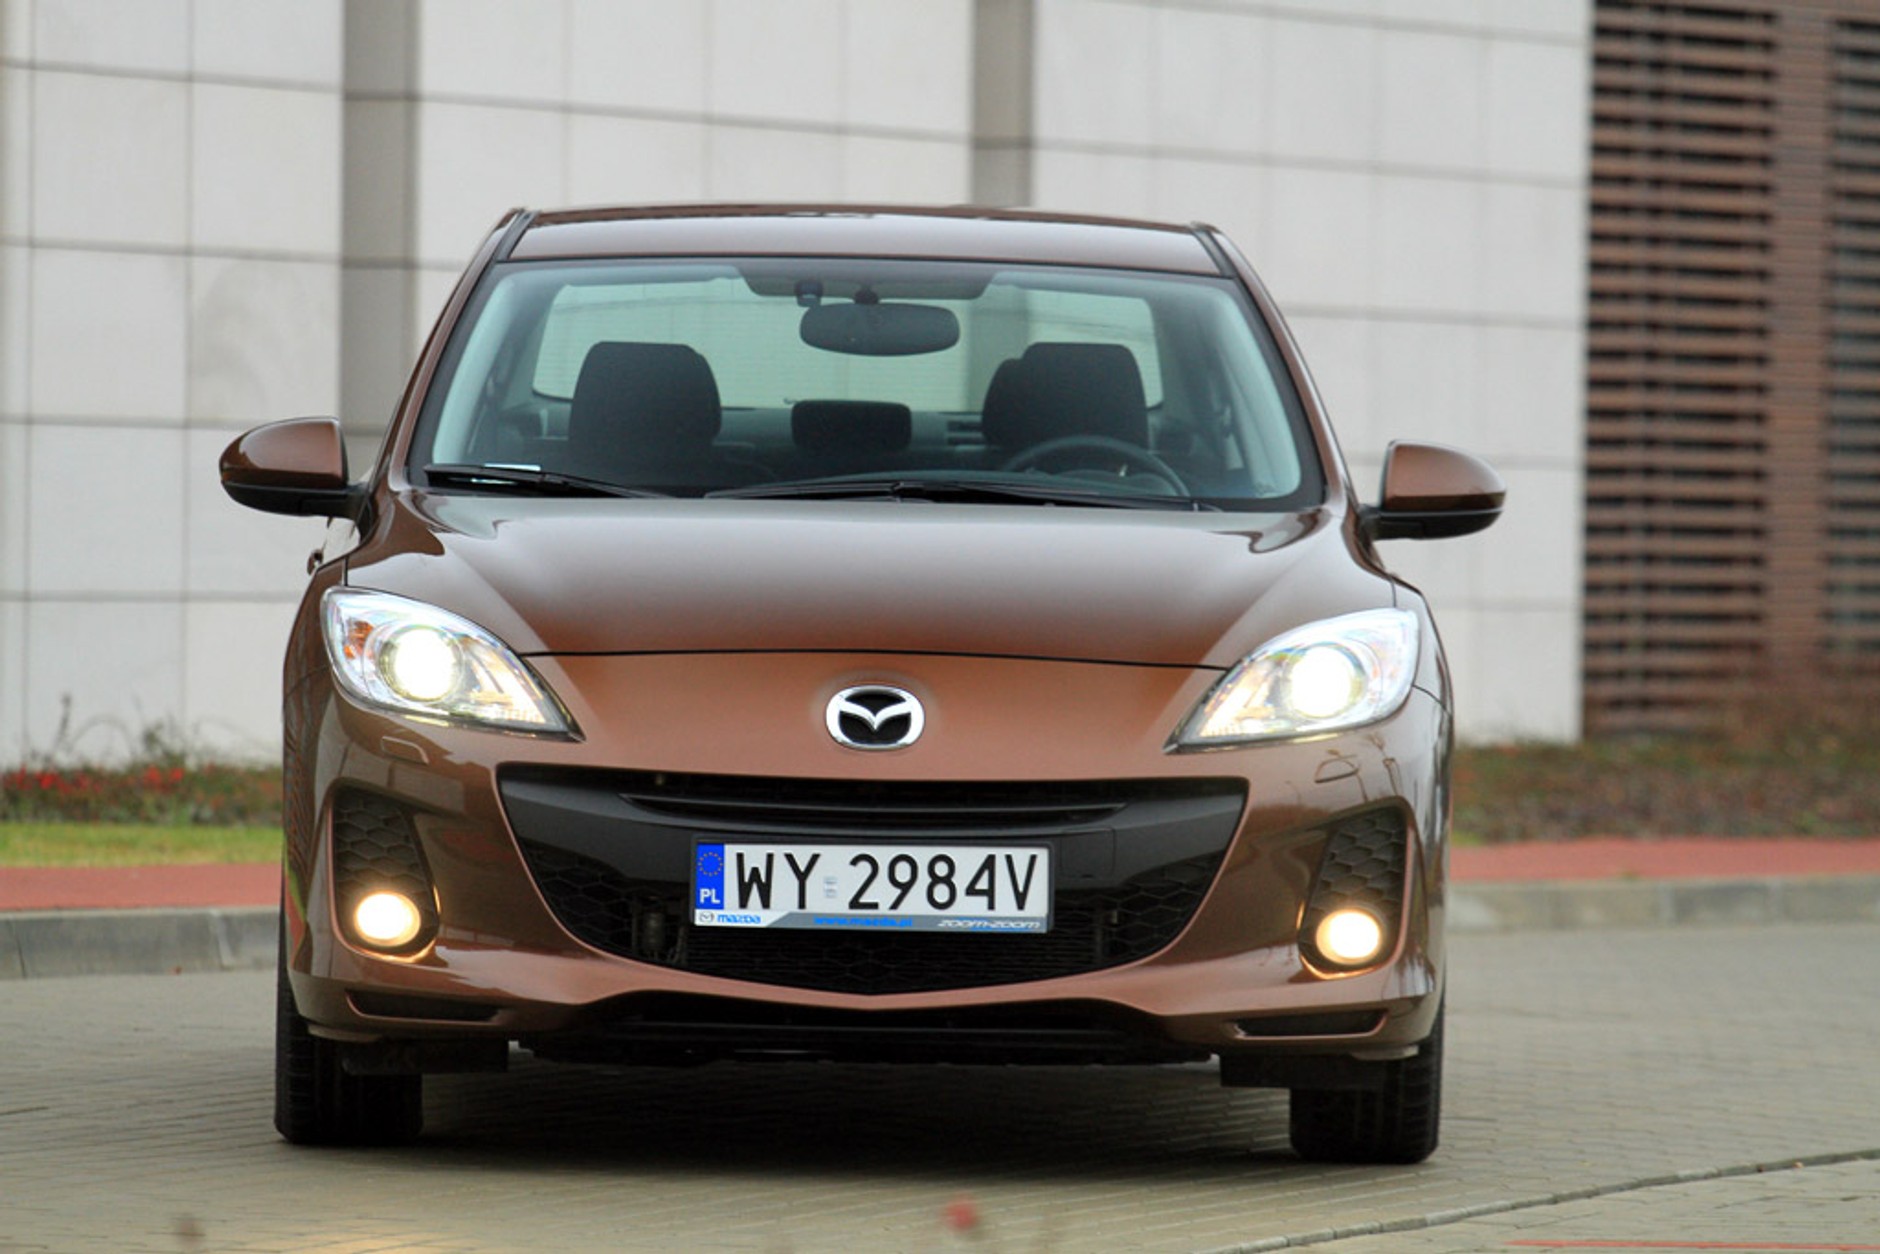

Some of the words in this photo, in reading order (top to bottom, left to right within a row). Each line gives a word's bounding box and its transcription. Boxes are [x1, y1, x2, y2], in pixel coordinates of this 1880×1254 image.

[700, 888, 721, 905] PL
[735, 852, 821, 910] WY
[848, 853, 1038, 911] 2984V
